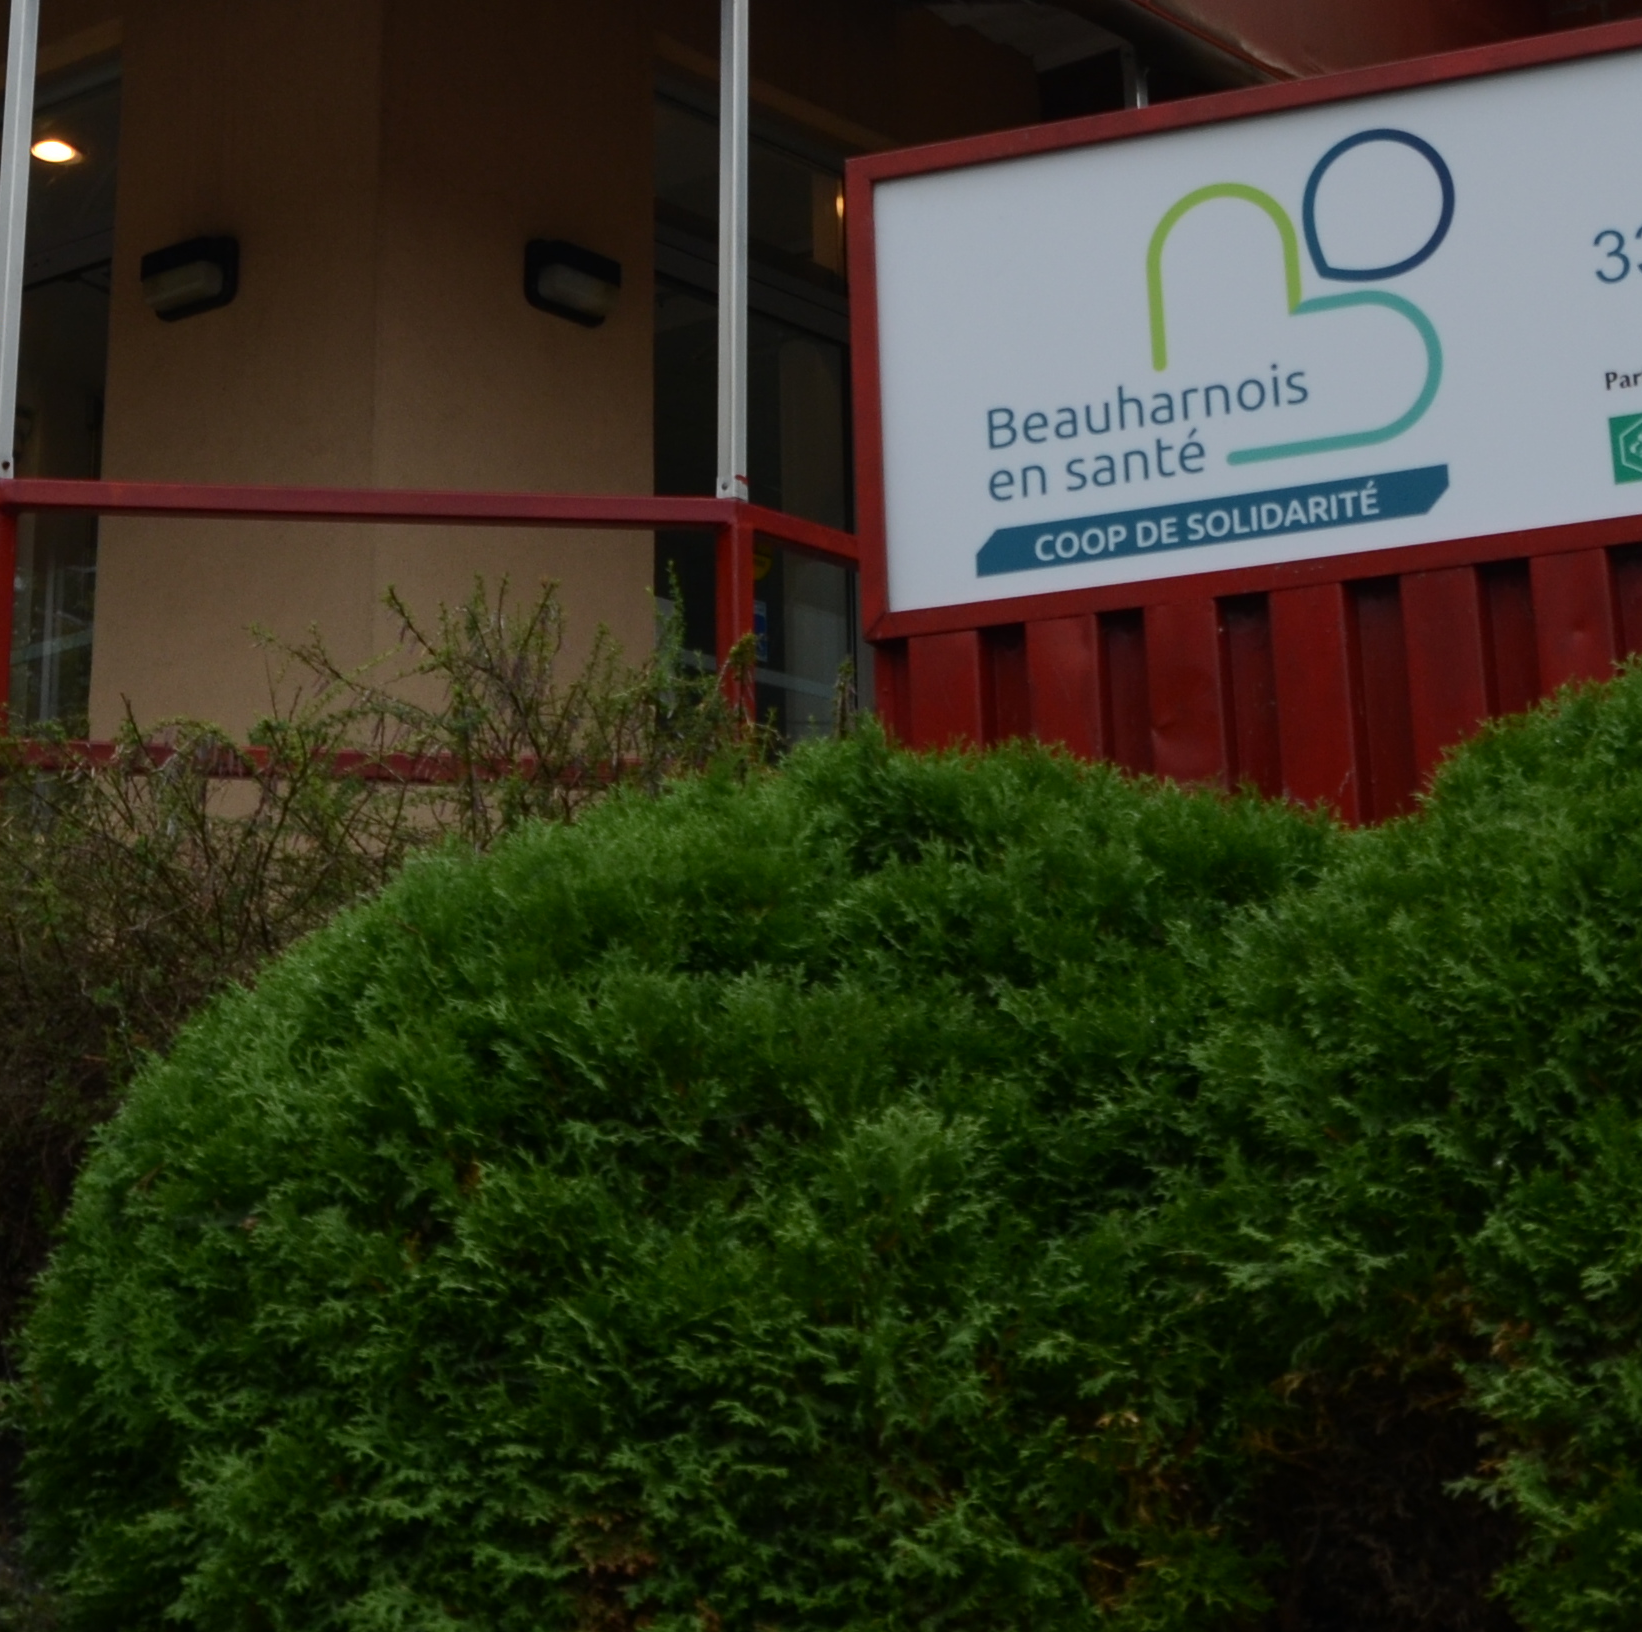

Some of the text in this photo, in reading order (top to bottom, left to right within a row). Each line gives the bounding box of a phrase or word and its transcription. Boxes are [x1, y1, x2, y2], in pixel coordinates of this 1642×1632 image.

[986, 363, 1310, 450] Beauharnois
[988, 428, 1207, 502] en santé
[1034, 481, 1381, 562] COOP DE SOLIDARITÉ
